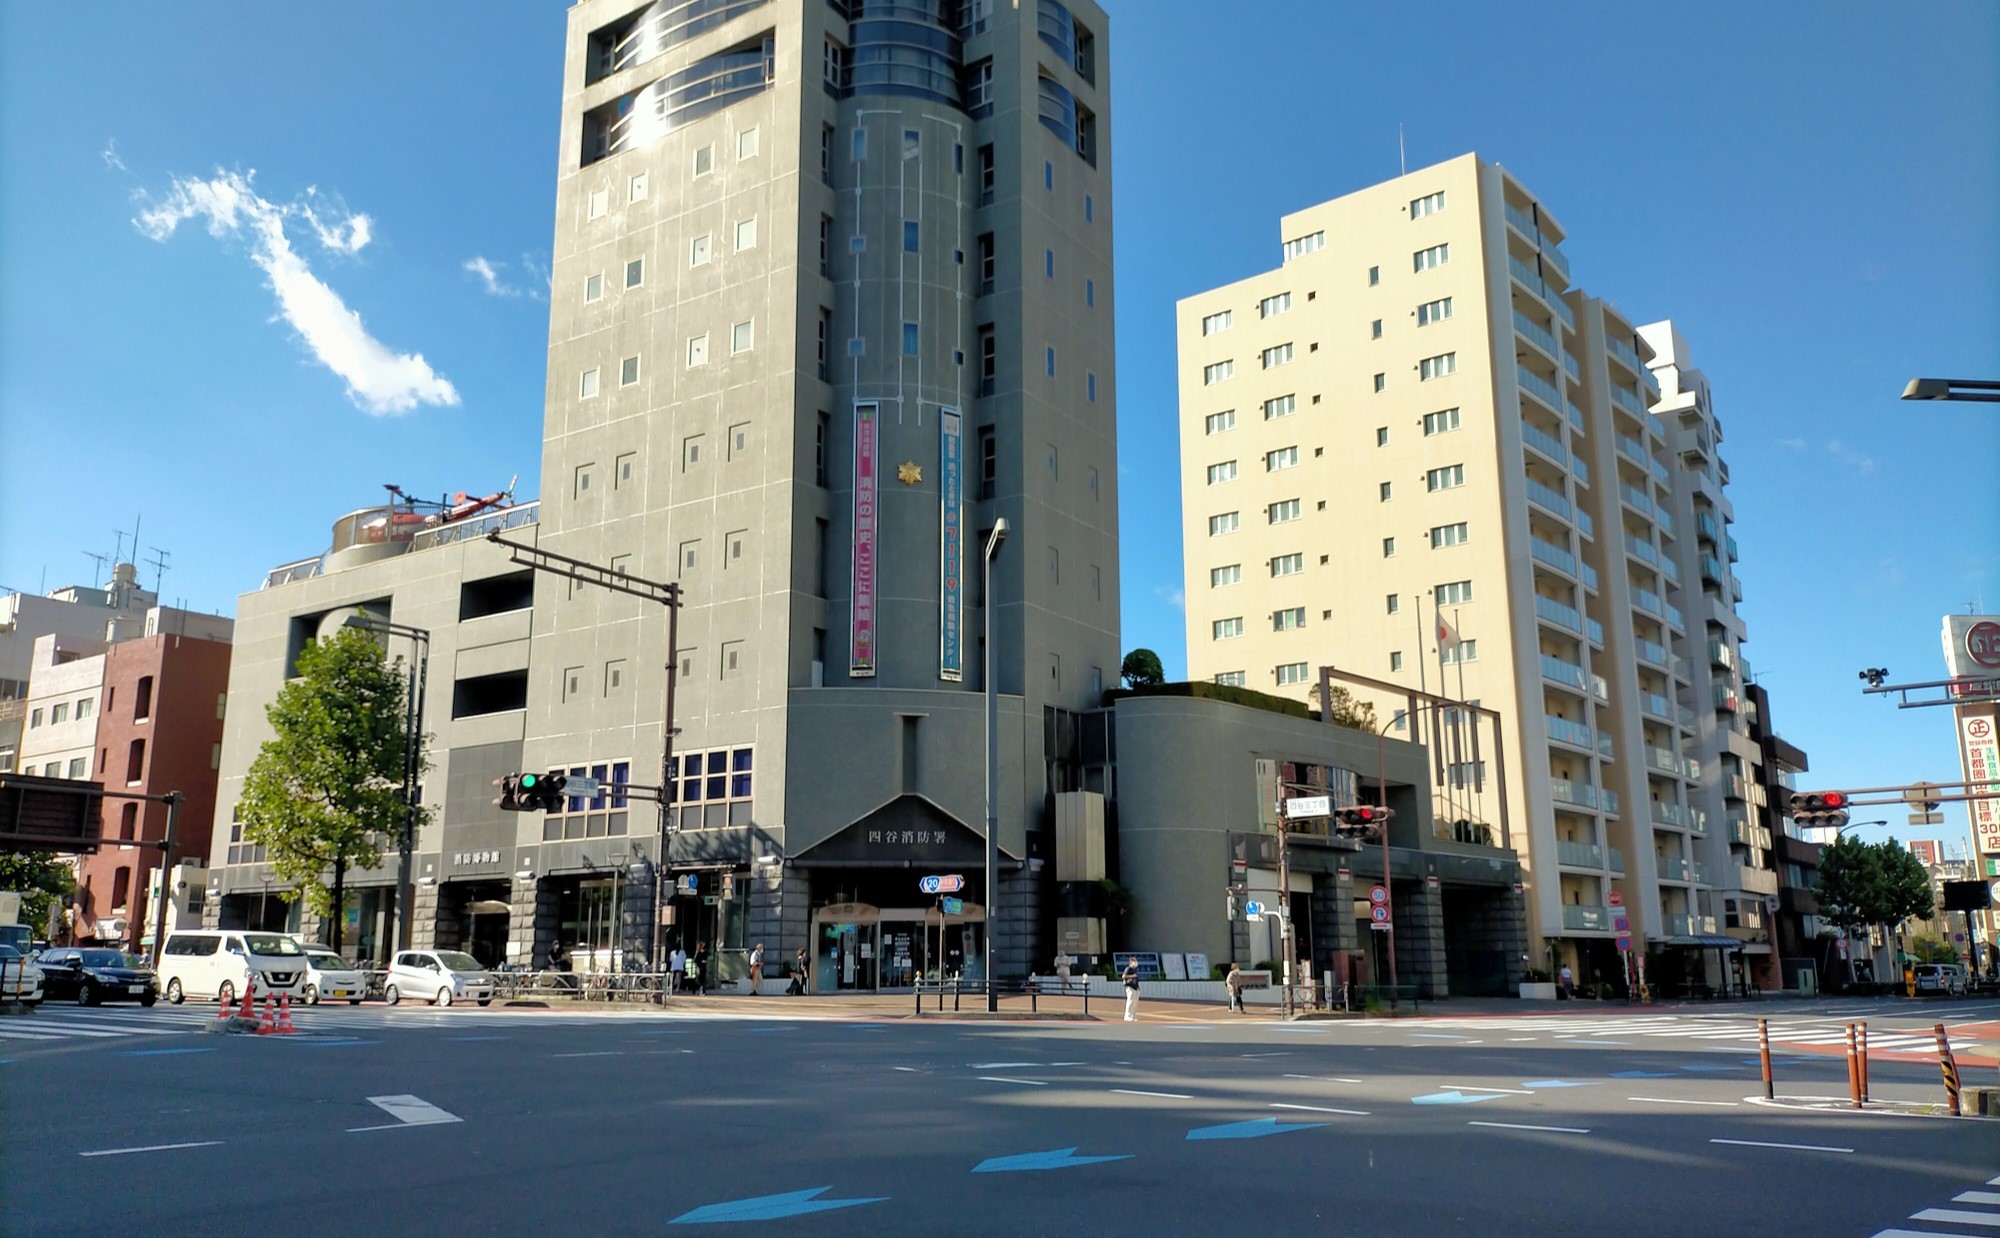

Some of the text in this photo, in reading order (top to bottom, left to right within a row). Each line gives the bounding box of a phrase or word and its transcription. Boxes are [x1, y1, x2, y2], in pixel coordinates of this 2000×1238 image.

[1980, 824, 2000, 834] 30
[868, 830, 946, 844] 四谷消防署
[927, 878, 937, 888] 20
[1373, 891, 1384, 900] 50
